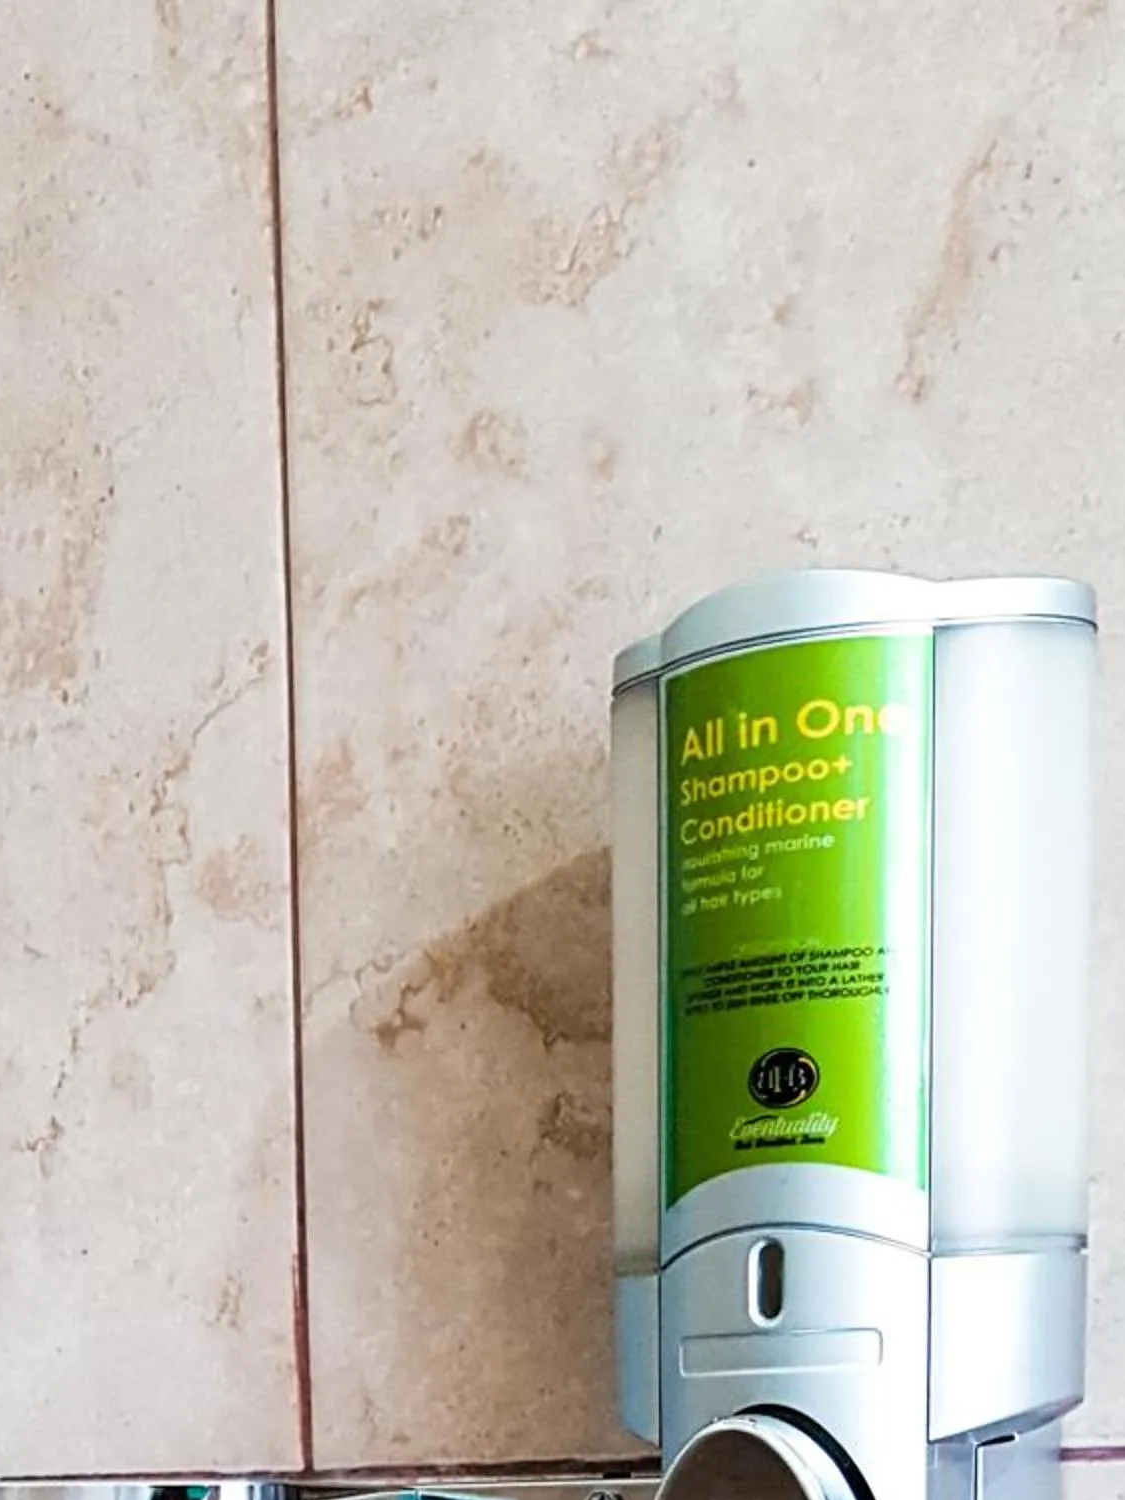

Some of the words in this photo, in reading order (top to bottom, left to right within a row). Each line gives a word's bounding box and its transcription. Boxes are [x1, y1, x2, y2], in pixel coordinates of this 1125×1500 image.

[680, 717, 724, 767] All
[739, 711, 778, 750] in
[680, 753, 854, 806] Shampoo+
[680, 796, 871, 845] Conditioner
[765, 833, 836, 854] marine
[741, 864, 764, 881] for
[700, 891, 729, 910] hair
[733, 885, 783, 906] types
[809, 947, 873, 960] SHAMPOO
